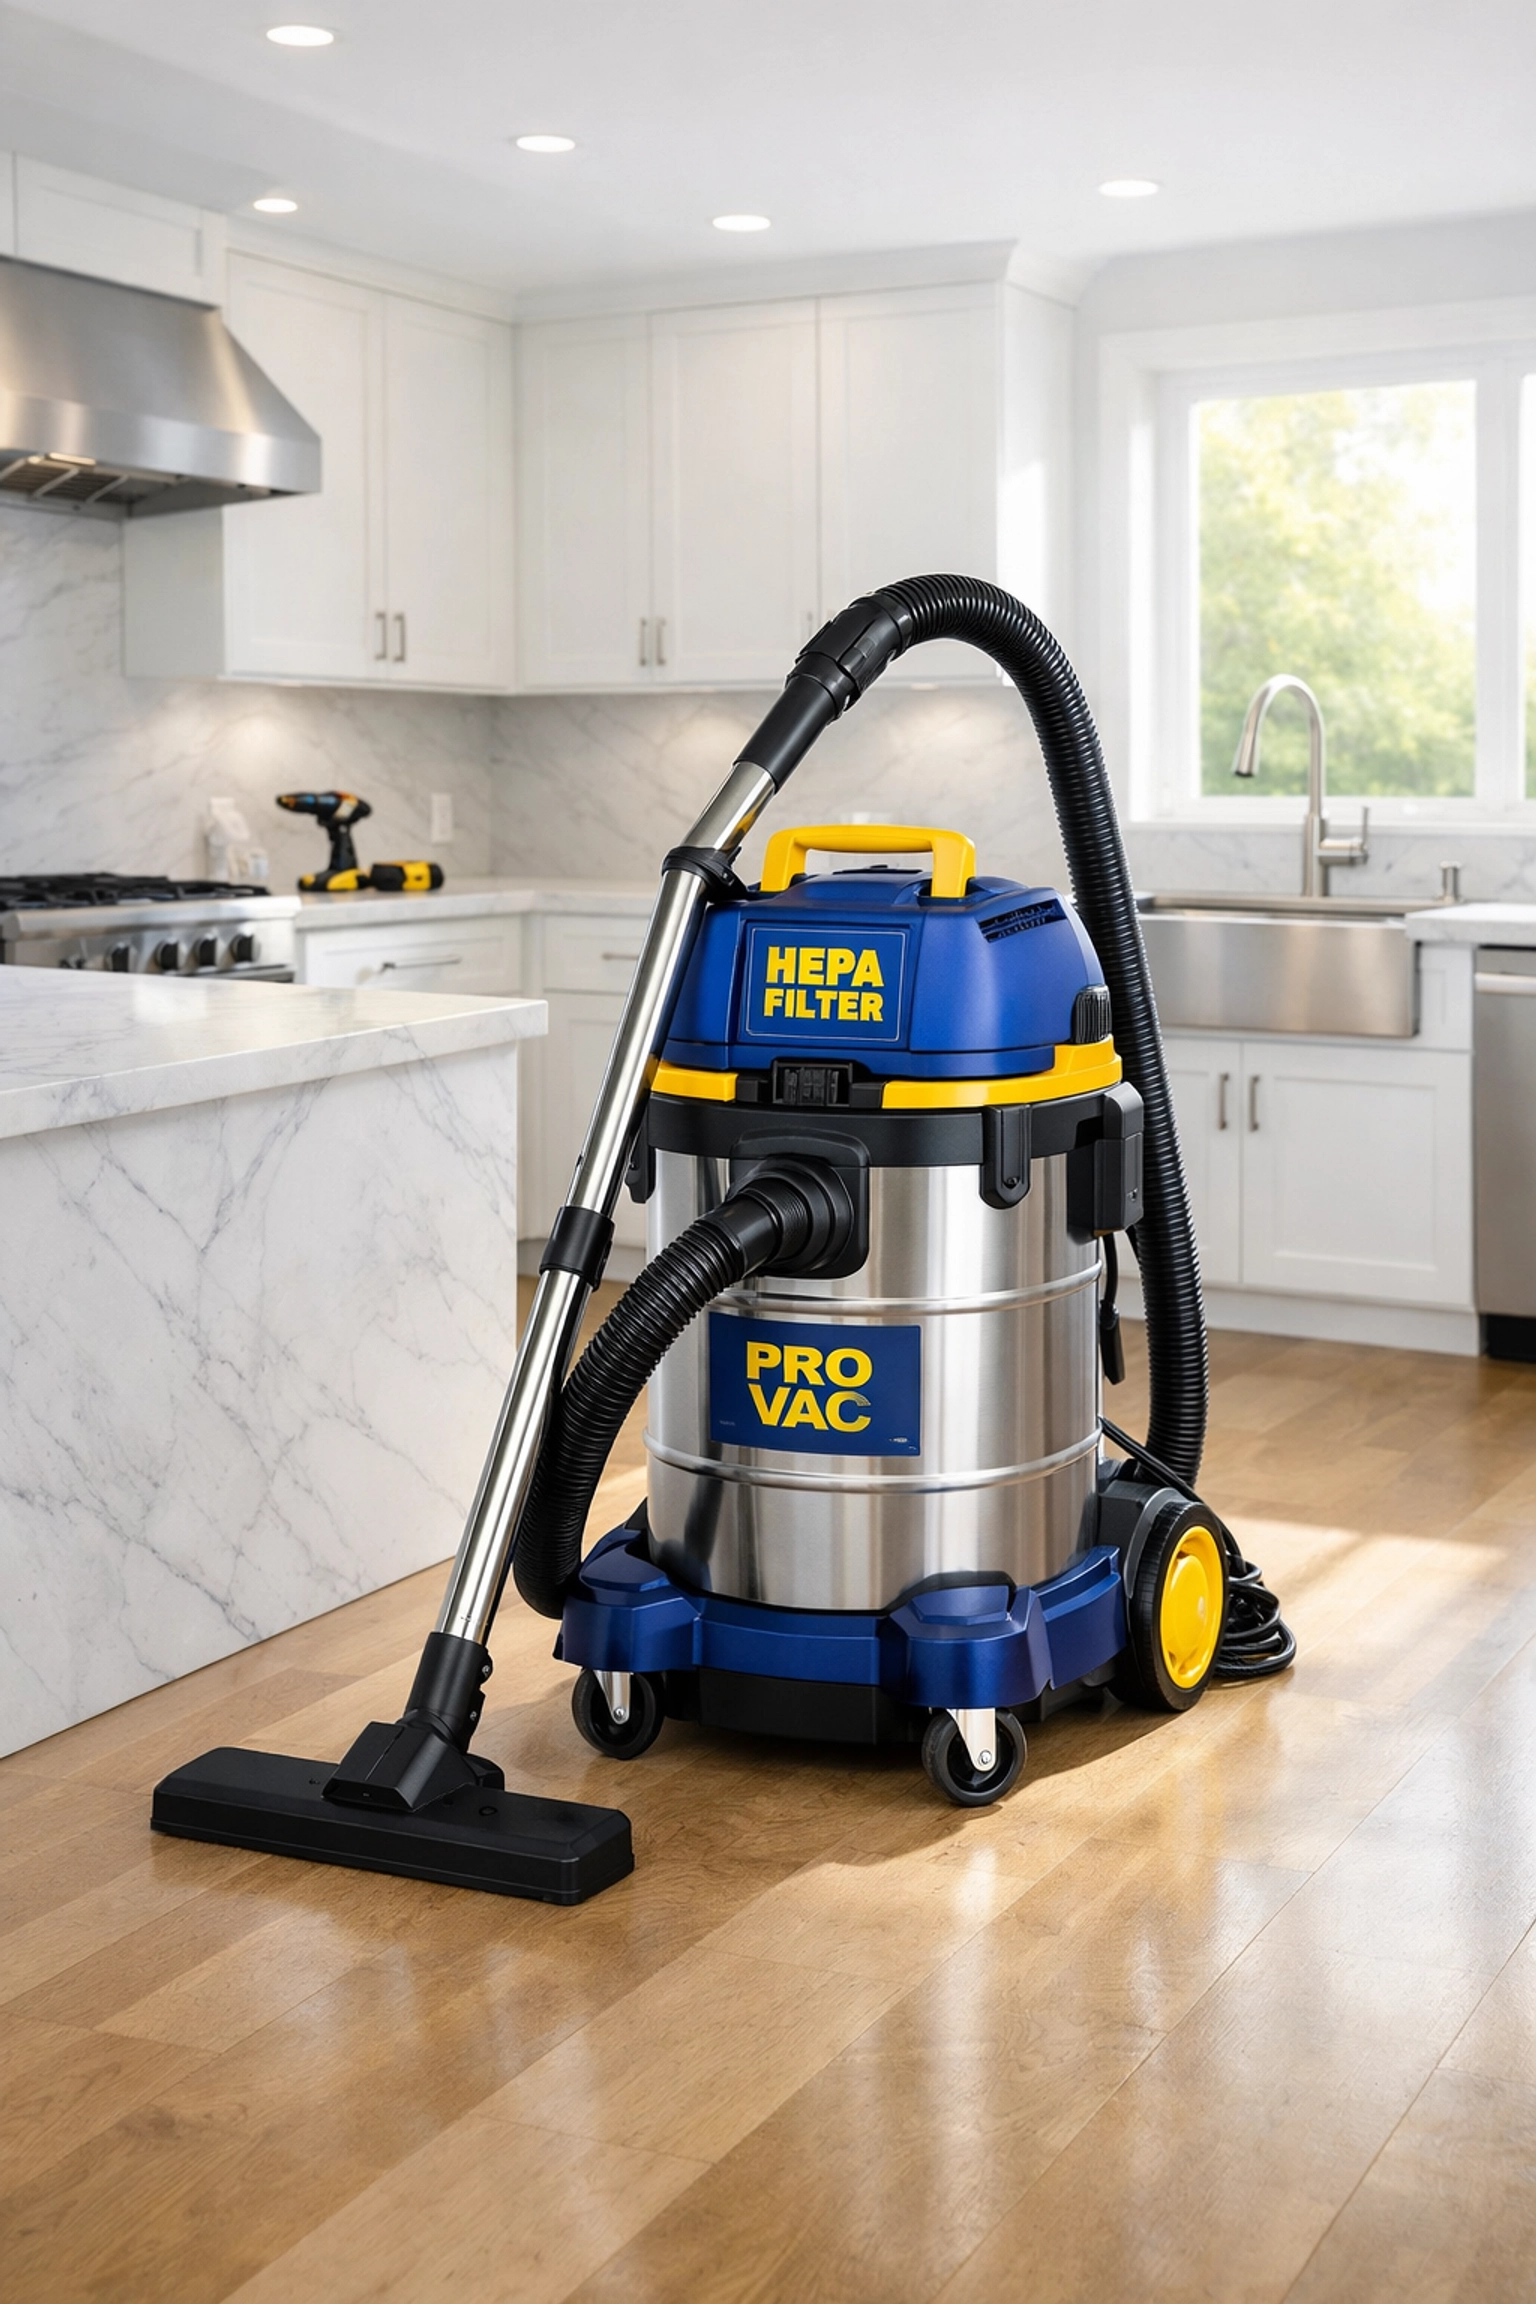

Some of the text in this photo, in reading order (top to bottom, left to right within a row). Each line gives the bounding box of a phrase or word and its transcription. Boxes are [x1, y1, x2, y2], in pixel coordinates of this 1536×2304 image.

[766, 946, 884, 987] HEPA
[764, 988, 883, 1022] FILTER
[746, 1341, 873, 1388] PRO
[748, 1383, 872, 1433] VAC
